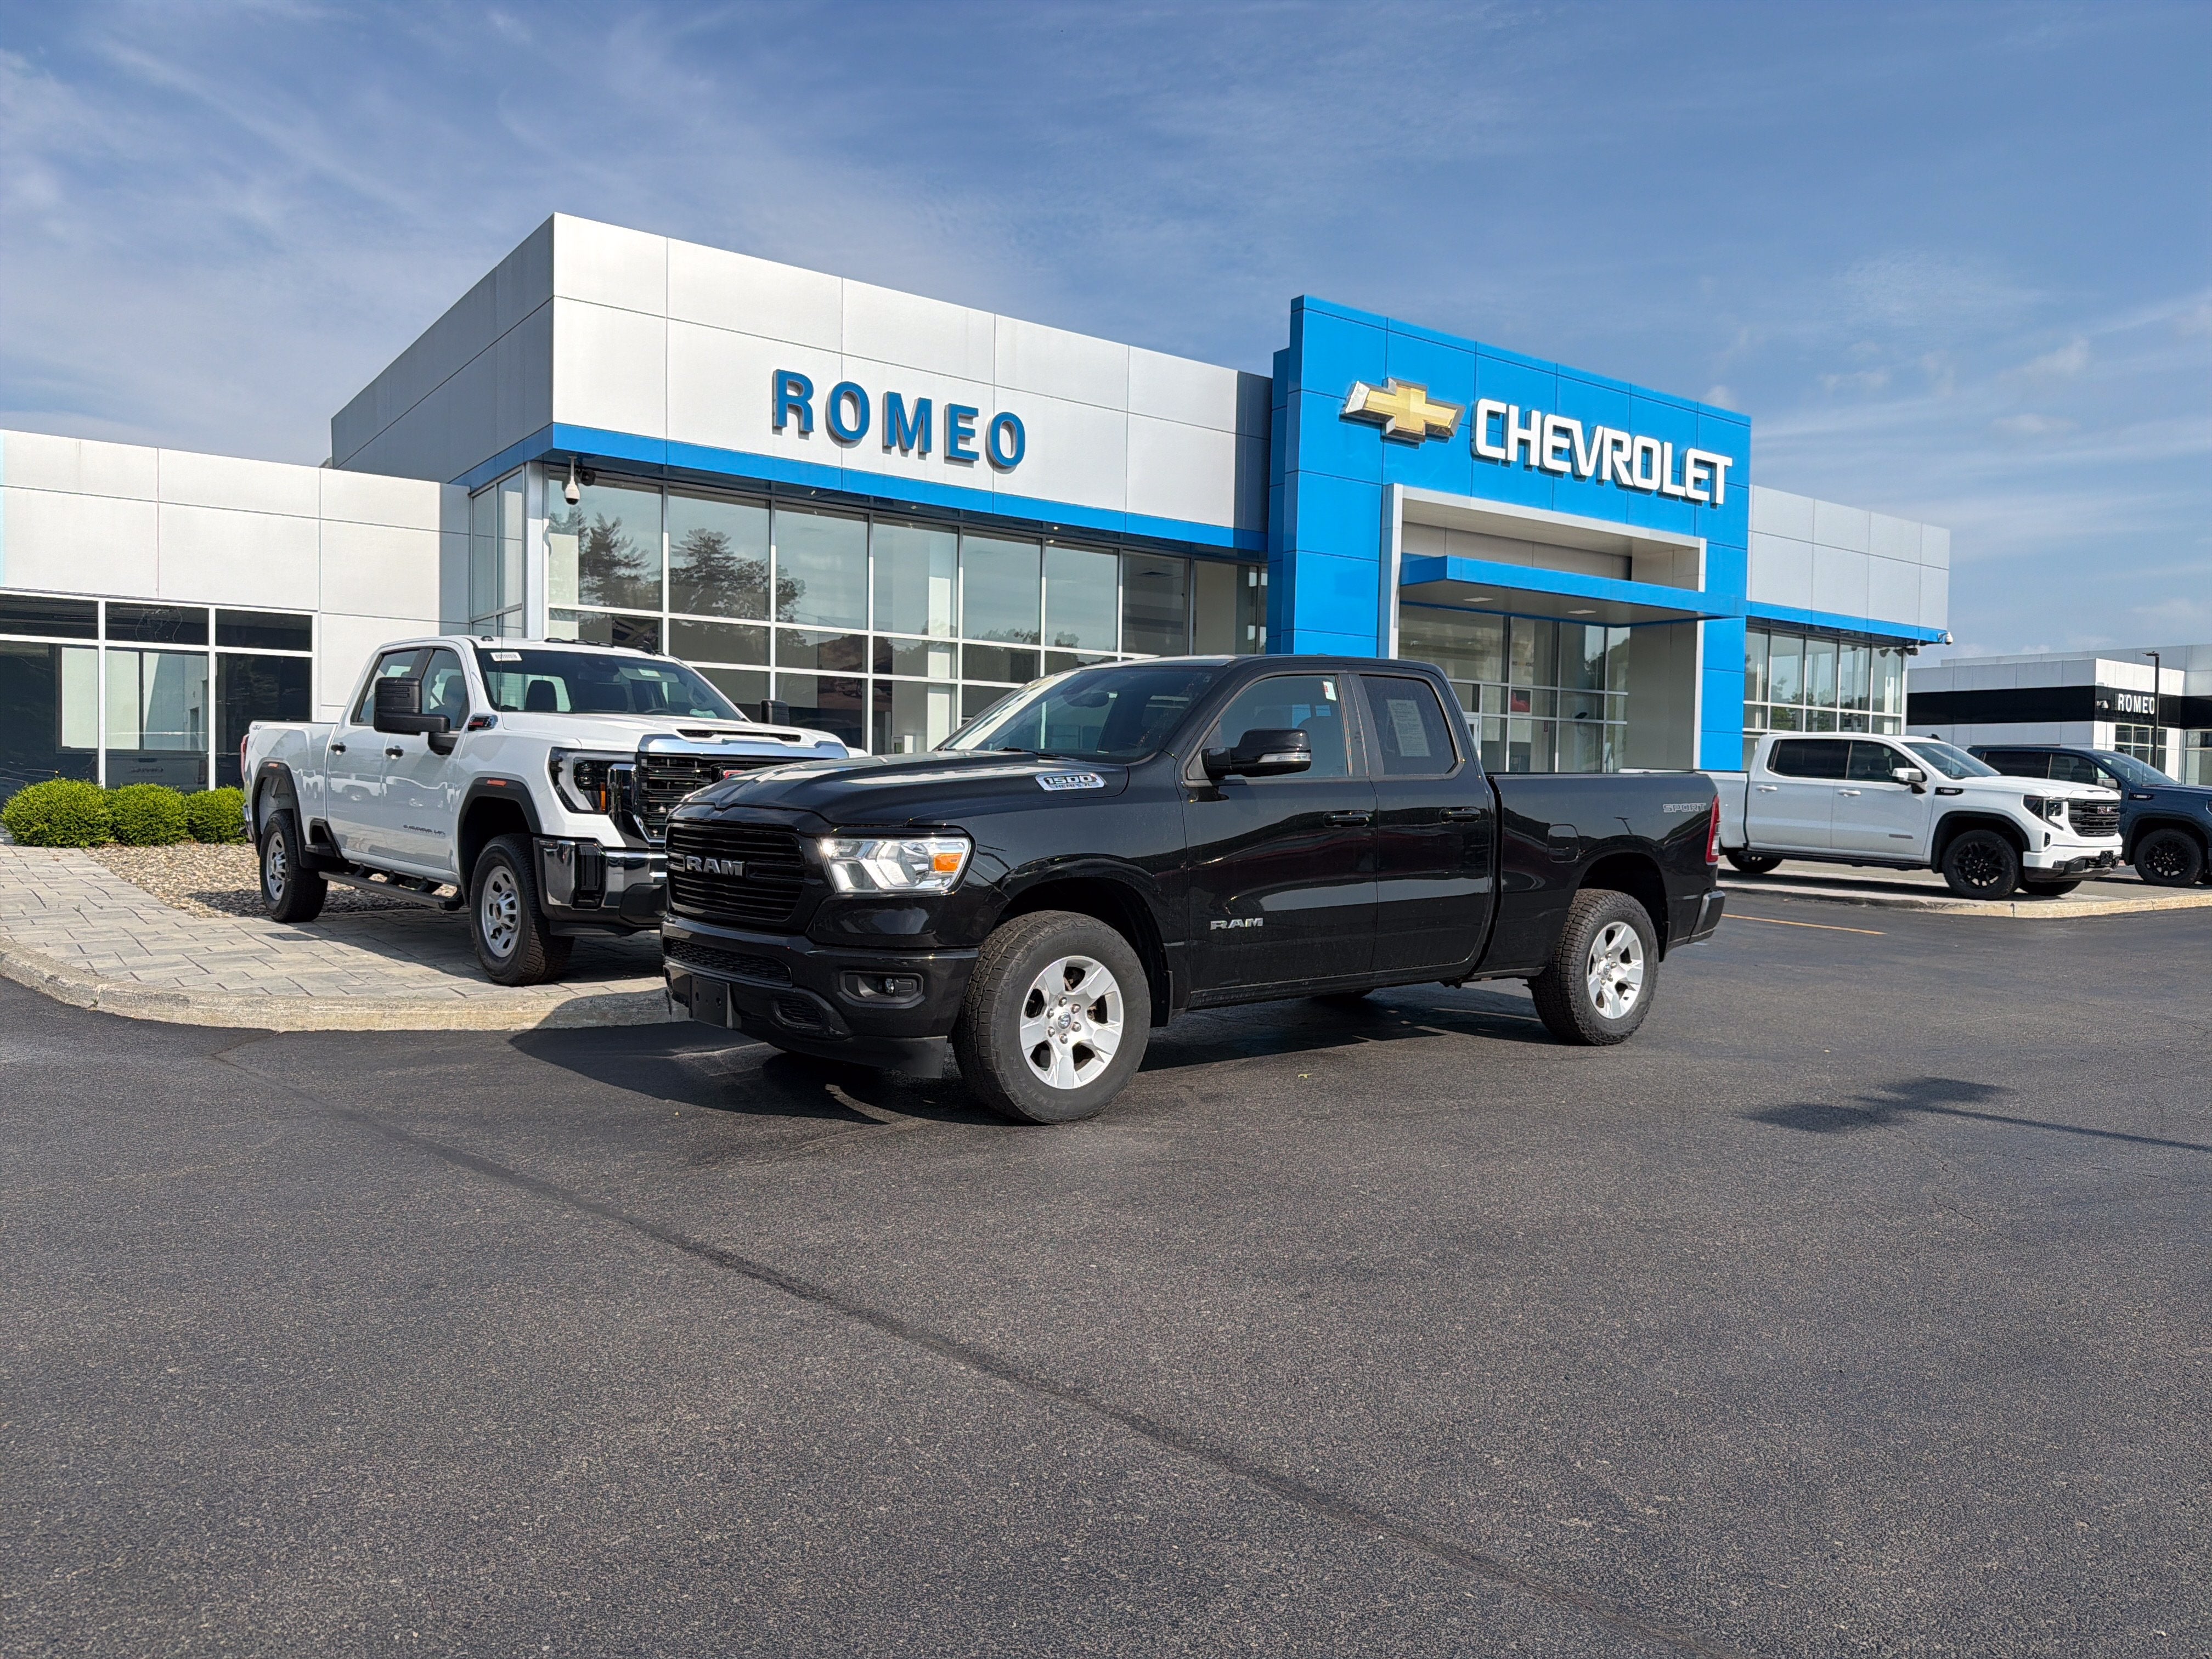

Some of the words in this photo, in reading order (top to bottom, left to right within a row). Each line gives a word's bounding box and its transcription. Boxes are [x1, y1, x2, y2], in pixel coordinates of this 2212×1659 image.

[772, 369, 1025, 468] ROMEO
[1474, 398, 1733, 505] CHEVROLET
[2118, 693, 2155, 714] ROMEO
[1045, 775, 1092, 785] 1500
[1662, 803, 1706, 813] SPORT
[686, 855, 745, 877] RAM
[1210, 917, 1263, 930] RAM
